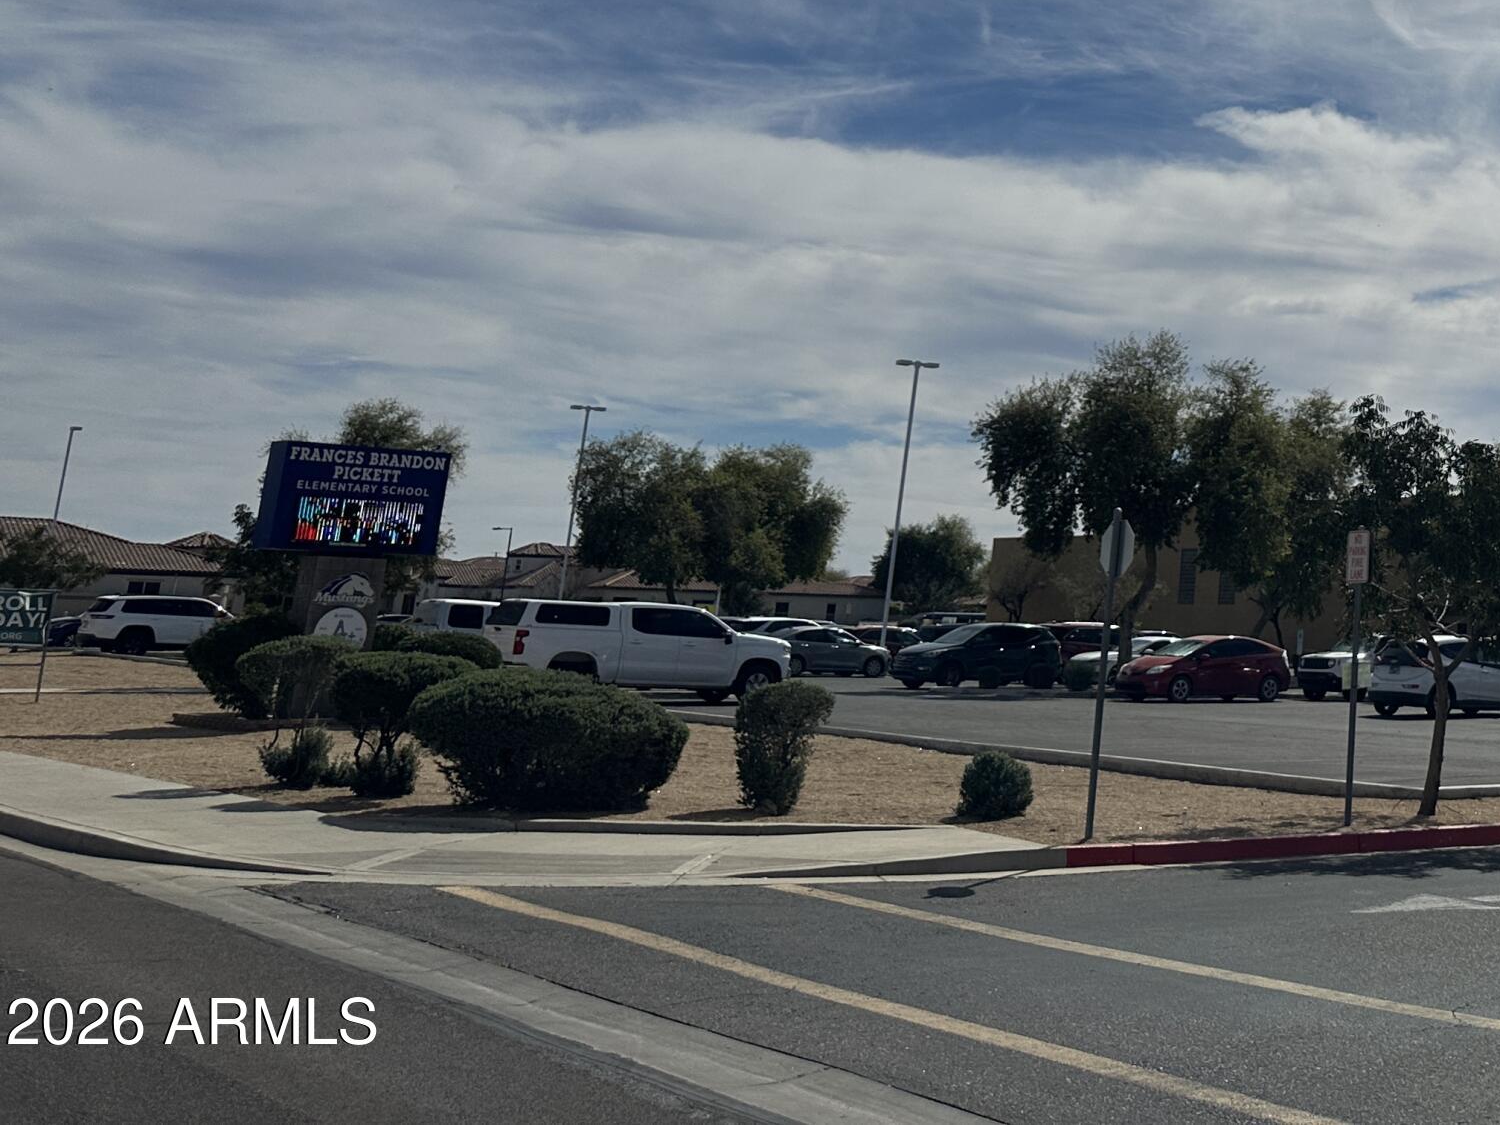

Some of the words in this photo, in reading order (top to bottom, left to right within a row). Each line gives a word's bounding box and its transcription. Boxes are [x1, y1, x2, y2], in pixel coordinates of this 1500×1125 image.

[289, 446, 365, 465] FRANCES
[369, 452, 447, 471] BRANDON
[332, 465, 402, 483] PICKETT
[296, 480, 378, 494] ELEMENTARY
[381, 486, 430, 498] SCHOOL
[312, 591, 375, 608] Mustangs
